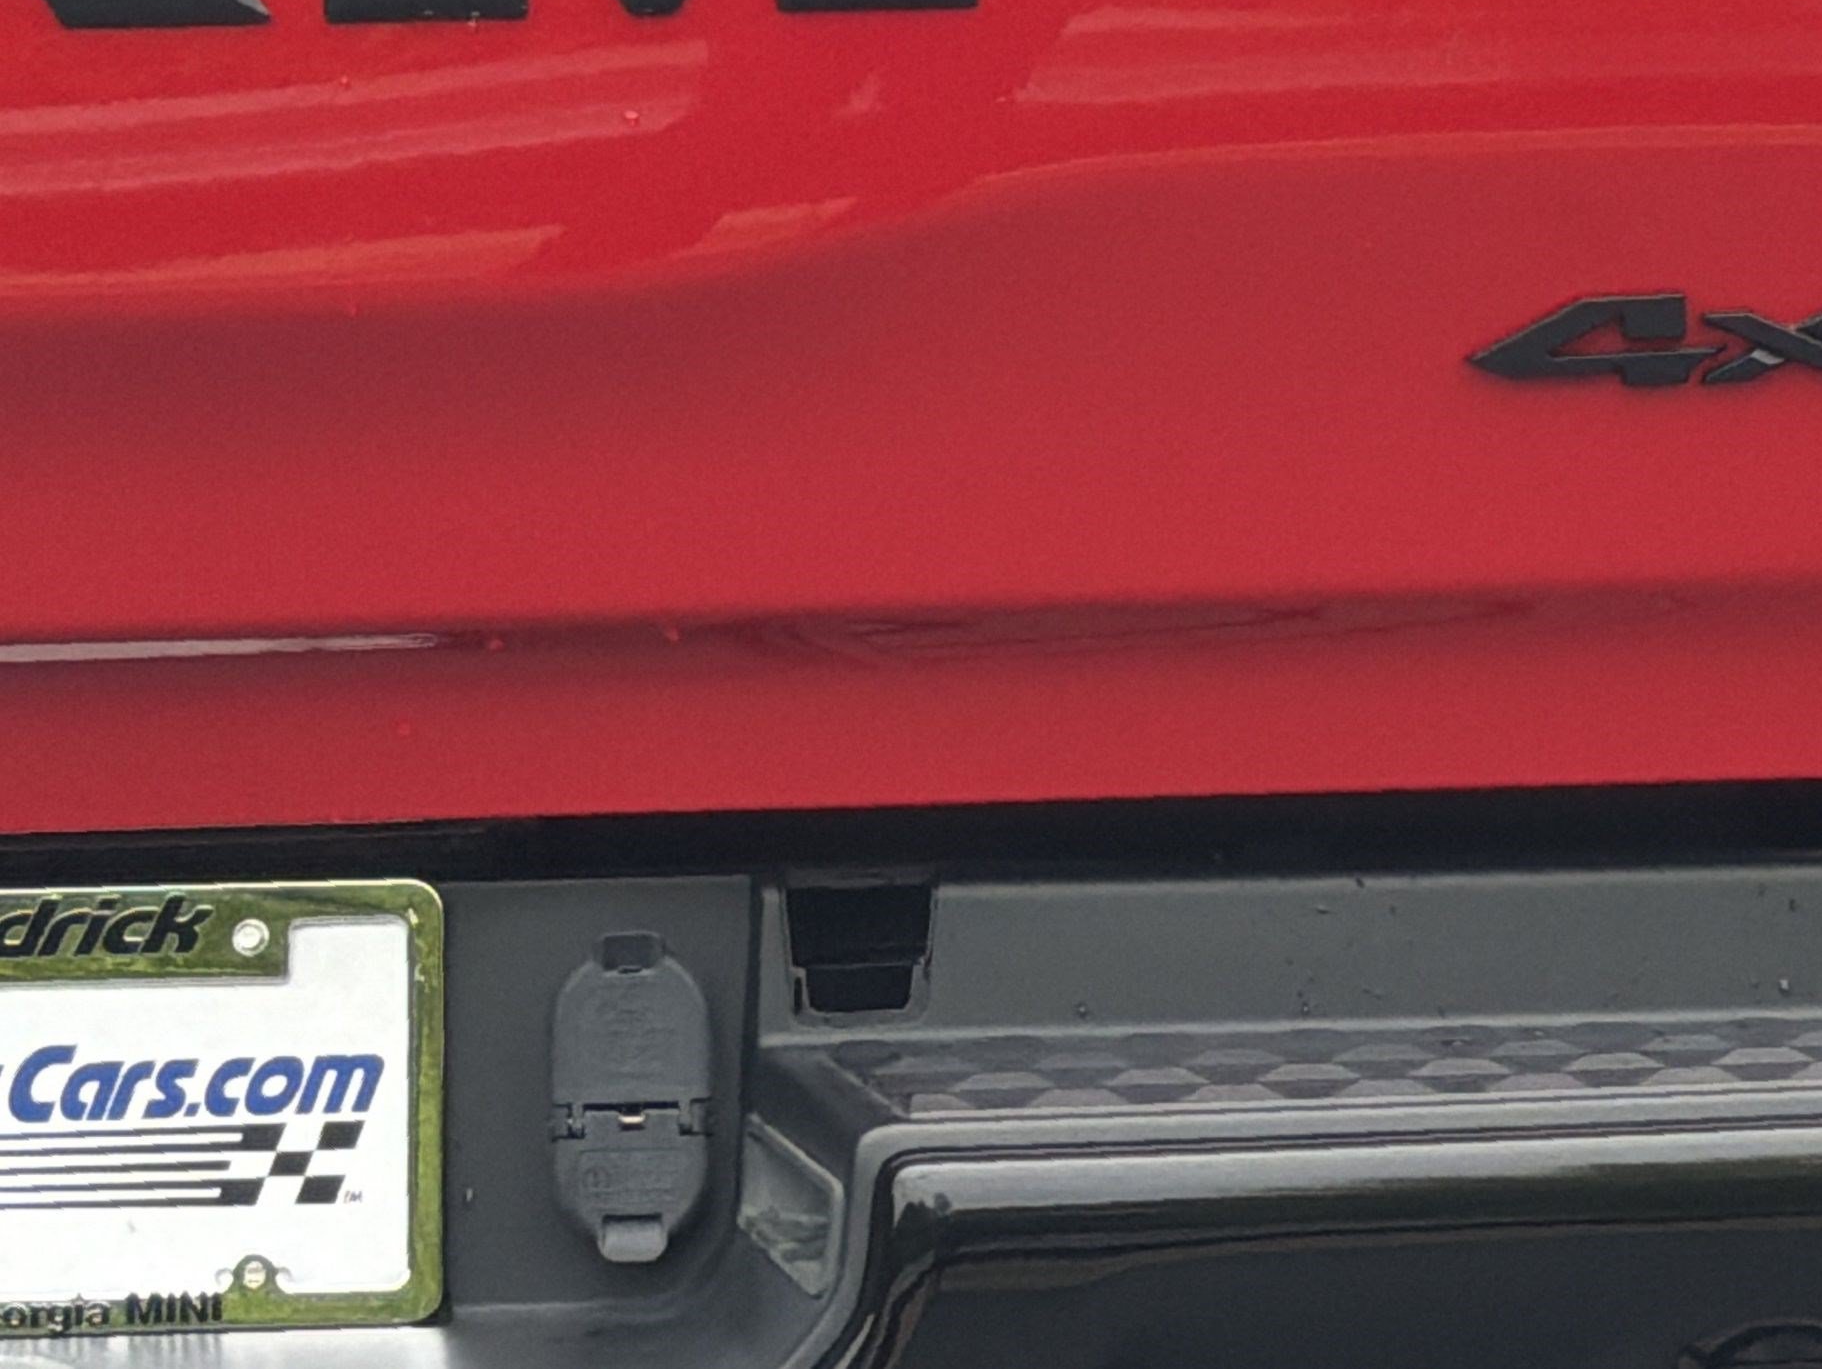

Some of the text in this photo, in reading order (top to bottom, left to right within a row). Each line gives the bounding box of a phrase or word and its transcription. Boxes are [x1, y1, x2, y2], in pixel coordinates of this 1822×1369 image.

[0, 894, 214, 957] drick
[0, 1044, 385, 1123] Cars.com
[124, 1290, 223, 1325] MINI
